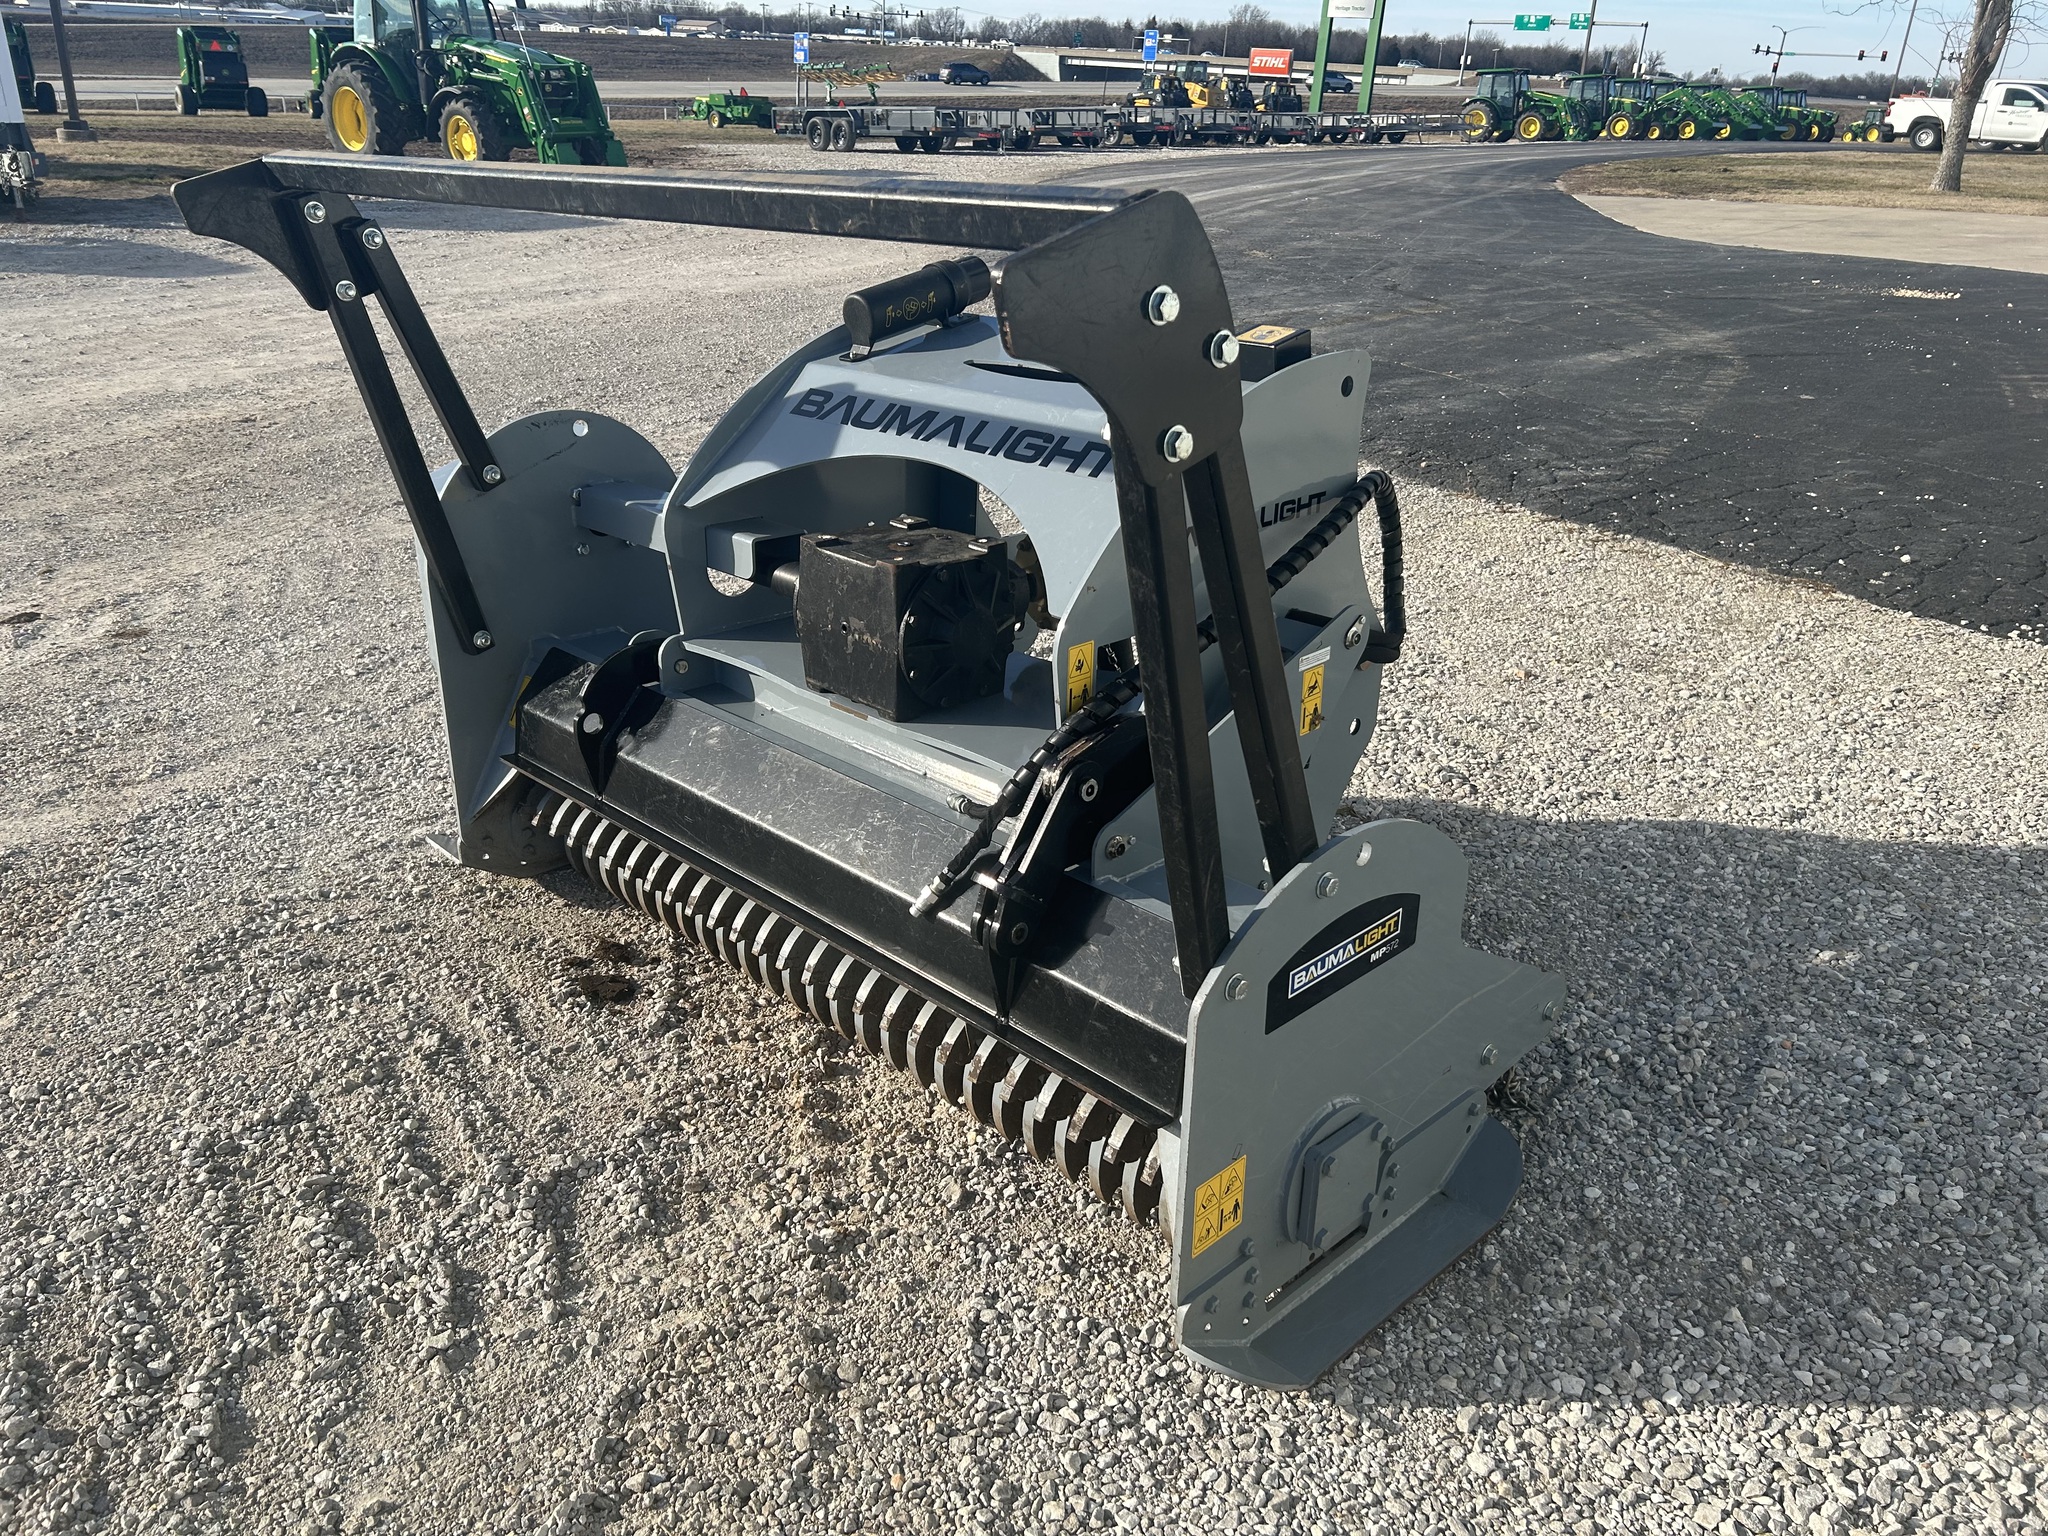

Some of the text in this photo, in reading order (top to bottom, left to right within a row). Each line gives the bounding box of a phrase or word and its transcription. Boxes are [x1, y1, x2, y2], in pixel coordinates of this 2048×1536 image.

[1252, 56, 1286, 68] STIHL
[789, 388, 1113, 478] BAUMALIGHT
[1293, 915, 1398, 989] BAUMALIGHT
[1370, 938, 1399, 963] MP572
